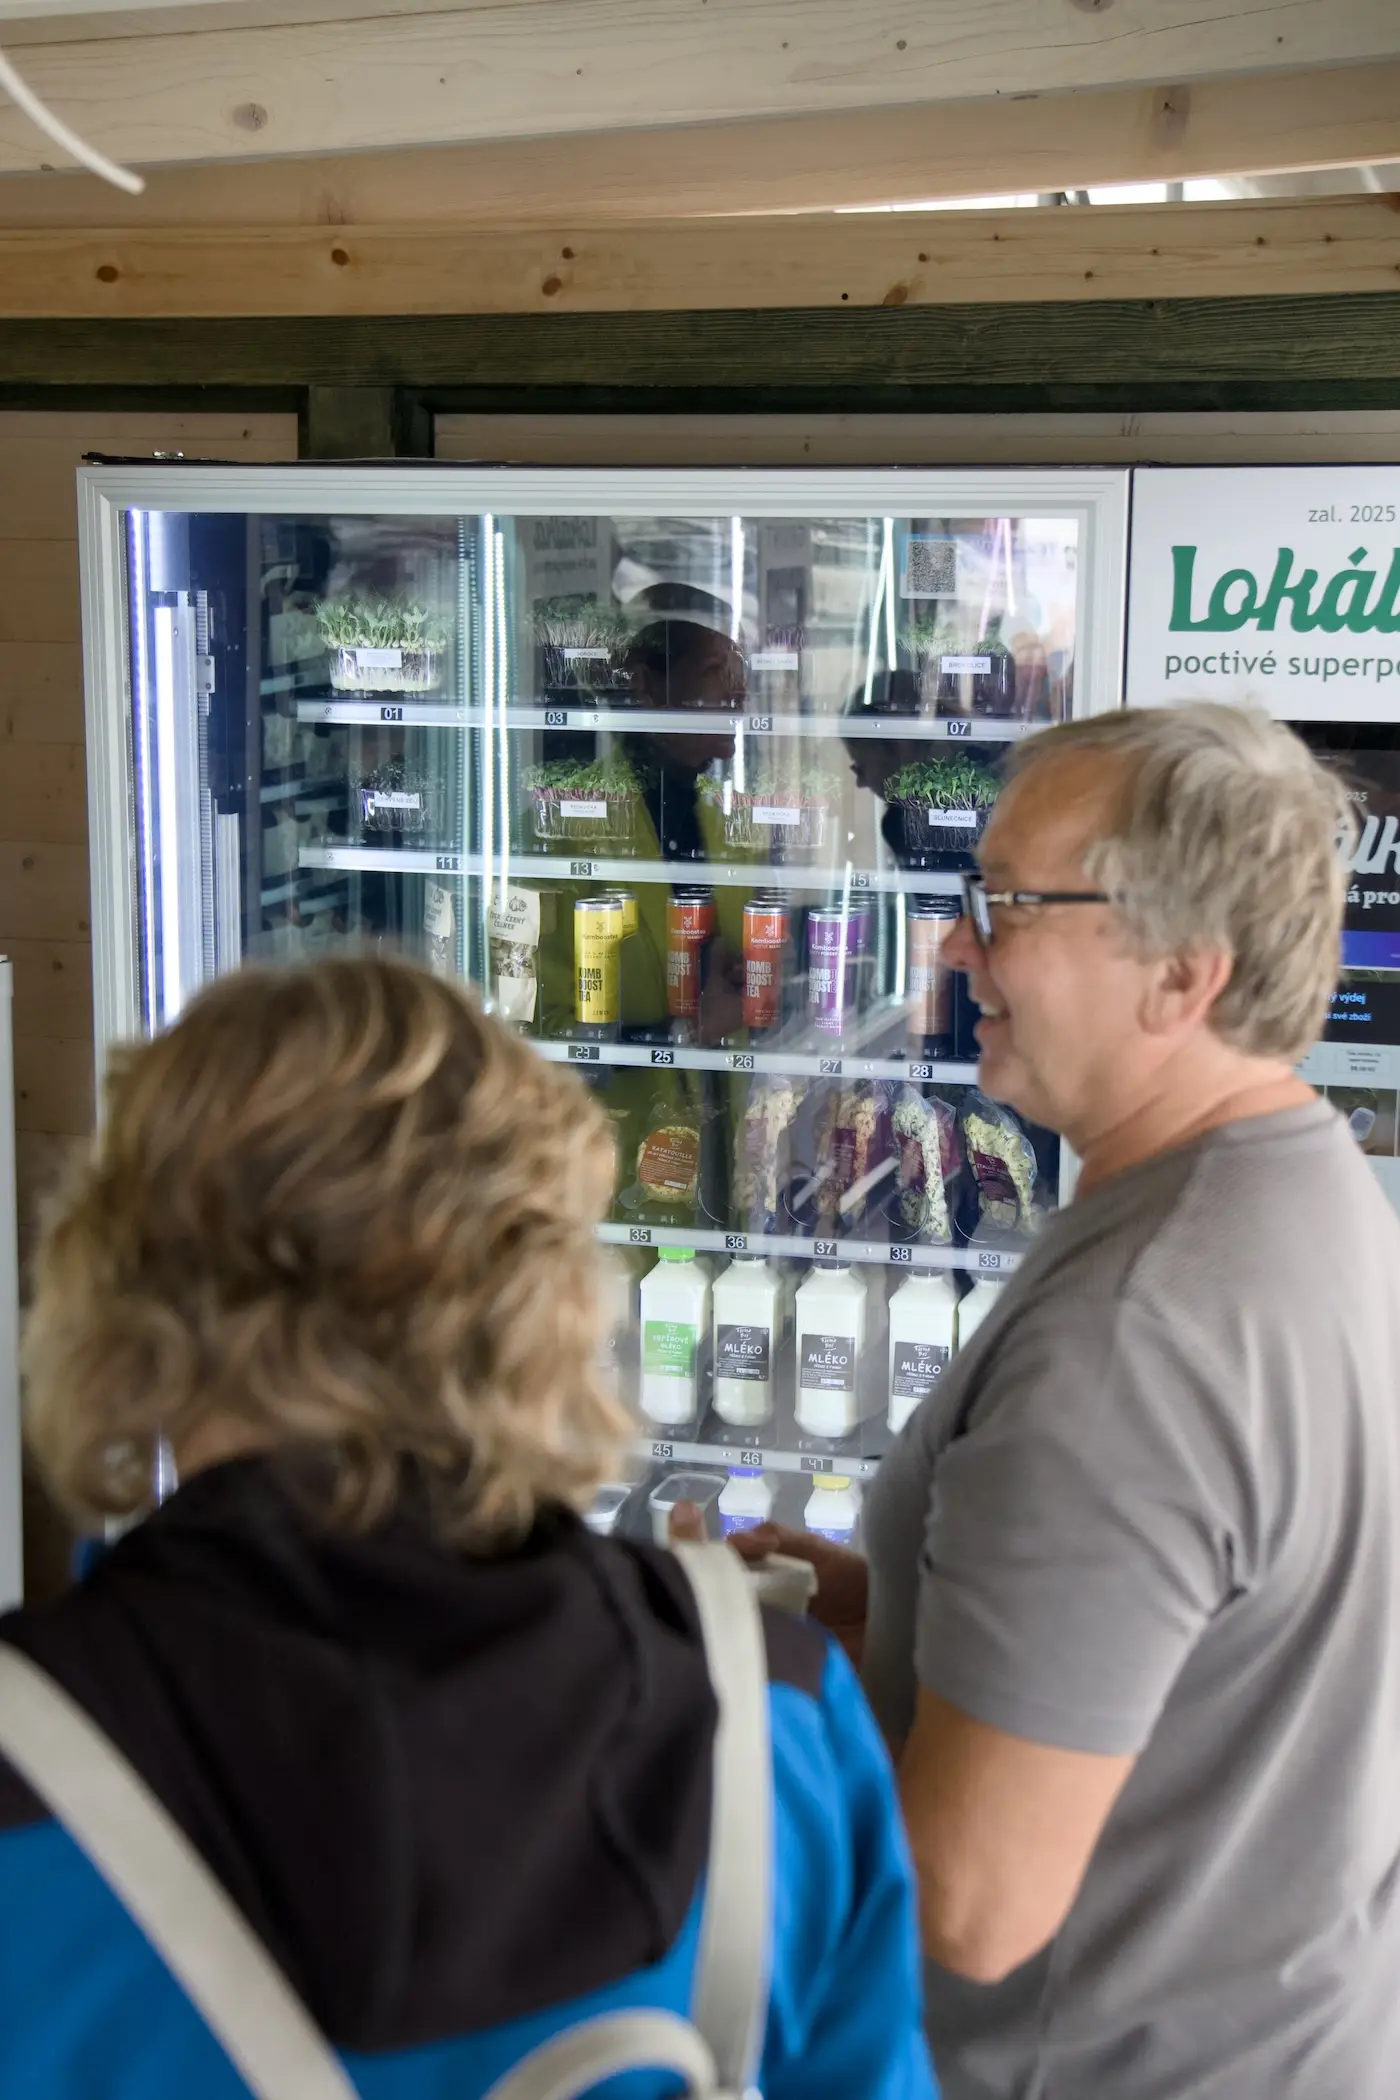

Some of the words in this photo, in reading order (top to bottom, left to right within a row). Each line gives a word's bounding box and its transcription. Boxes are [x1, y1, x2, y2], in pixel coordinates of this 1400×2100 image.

[1308, 505, 1343, 523] zal.
[1350, 505, 1396, 523] 2025
[1165, 650, 1277, 680] poctivé
[384, 707, 399, 720] 01
[547, 712, 564, 724] 03
[752, 717, 769, 730] 05
[950, 722, 968, 735] 07
[438, 857, 454, 869] 11
[573, 863, 589, 875] 13
[850, 873, 866, 886] 15
[746, 959, 772, 974] KOMB
[746, 972, 773, 986] BOOST
[746, 985, 760, 998] TEA
[1339, 992, 1366, 1005] výdej
[576, 1046, 590, 1059] 23
[655, 1050, 671, 1063] 25
[735, 1055, 752, 1068] 26
[821, 1060, 838, 1073] 27
[912, 1064, 929, 1078] 28
[631, 1229, 648, 1242] 35
[727, 1236, 744, 1249] 36
[816, 1242, 834, 1255] 37
[892, 1247, 909, 1261] 38
[981, 1254, 998, 1267] 39
[724, 1341, 763, 1355] MLÉKO
[808, 1351, 848, 1365] MLÉKO
[901, 1360, 941, 1374] MLÉKO
[654, 1444, 670, 1457] 45
[743, 1451, 759, 1465] 46
